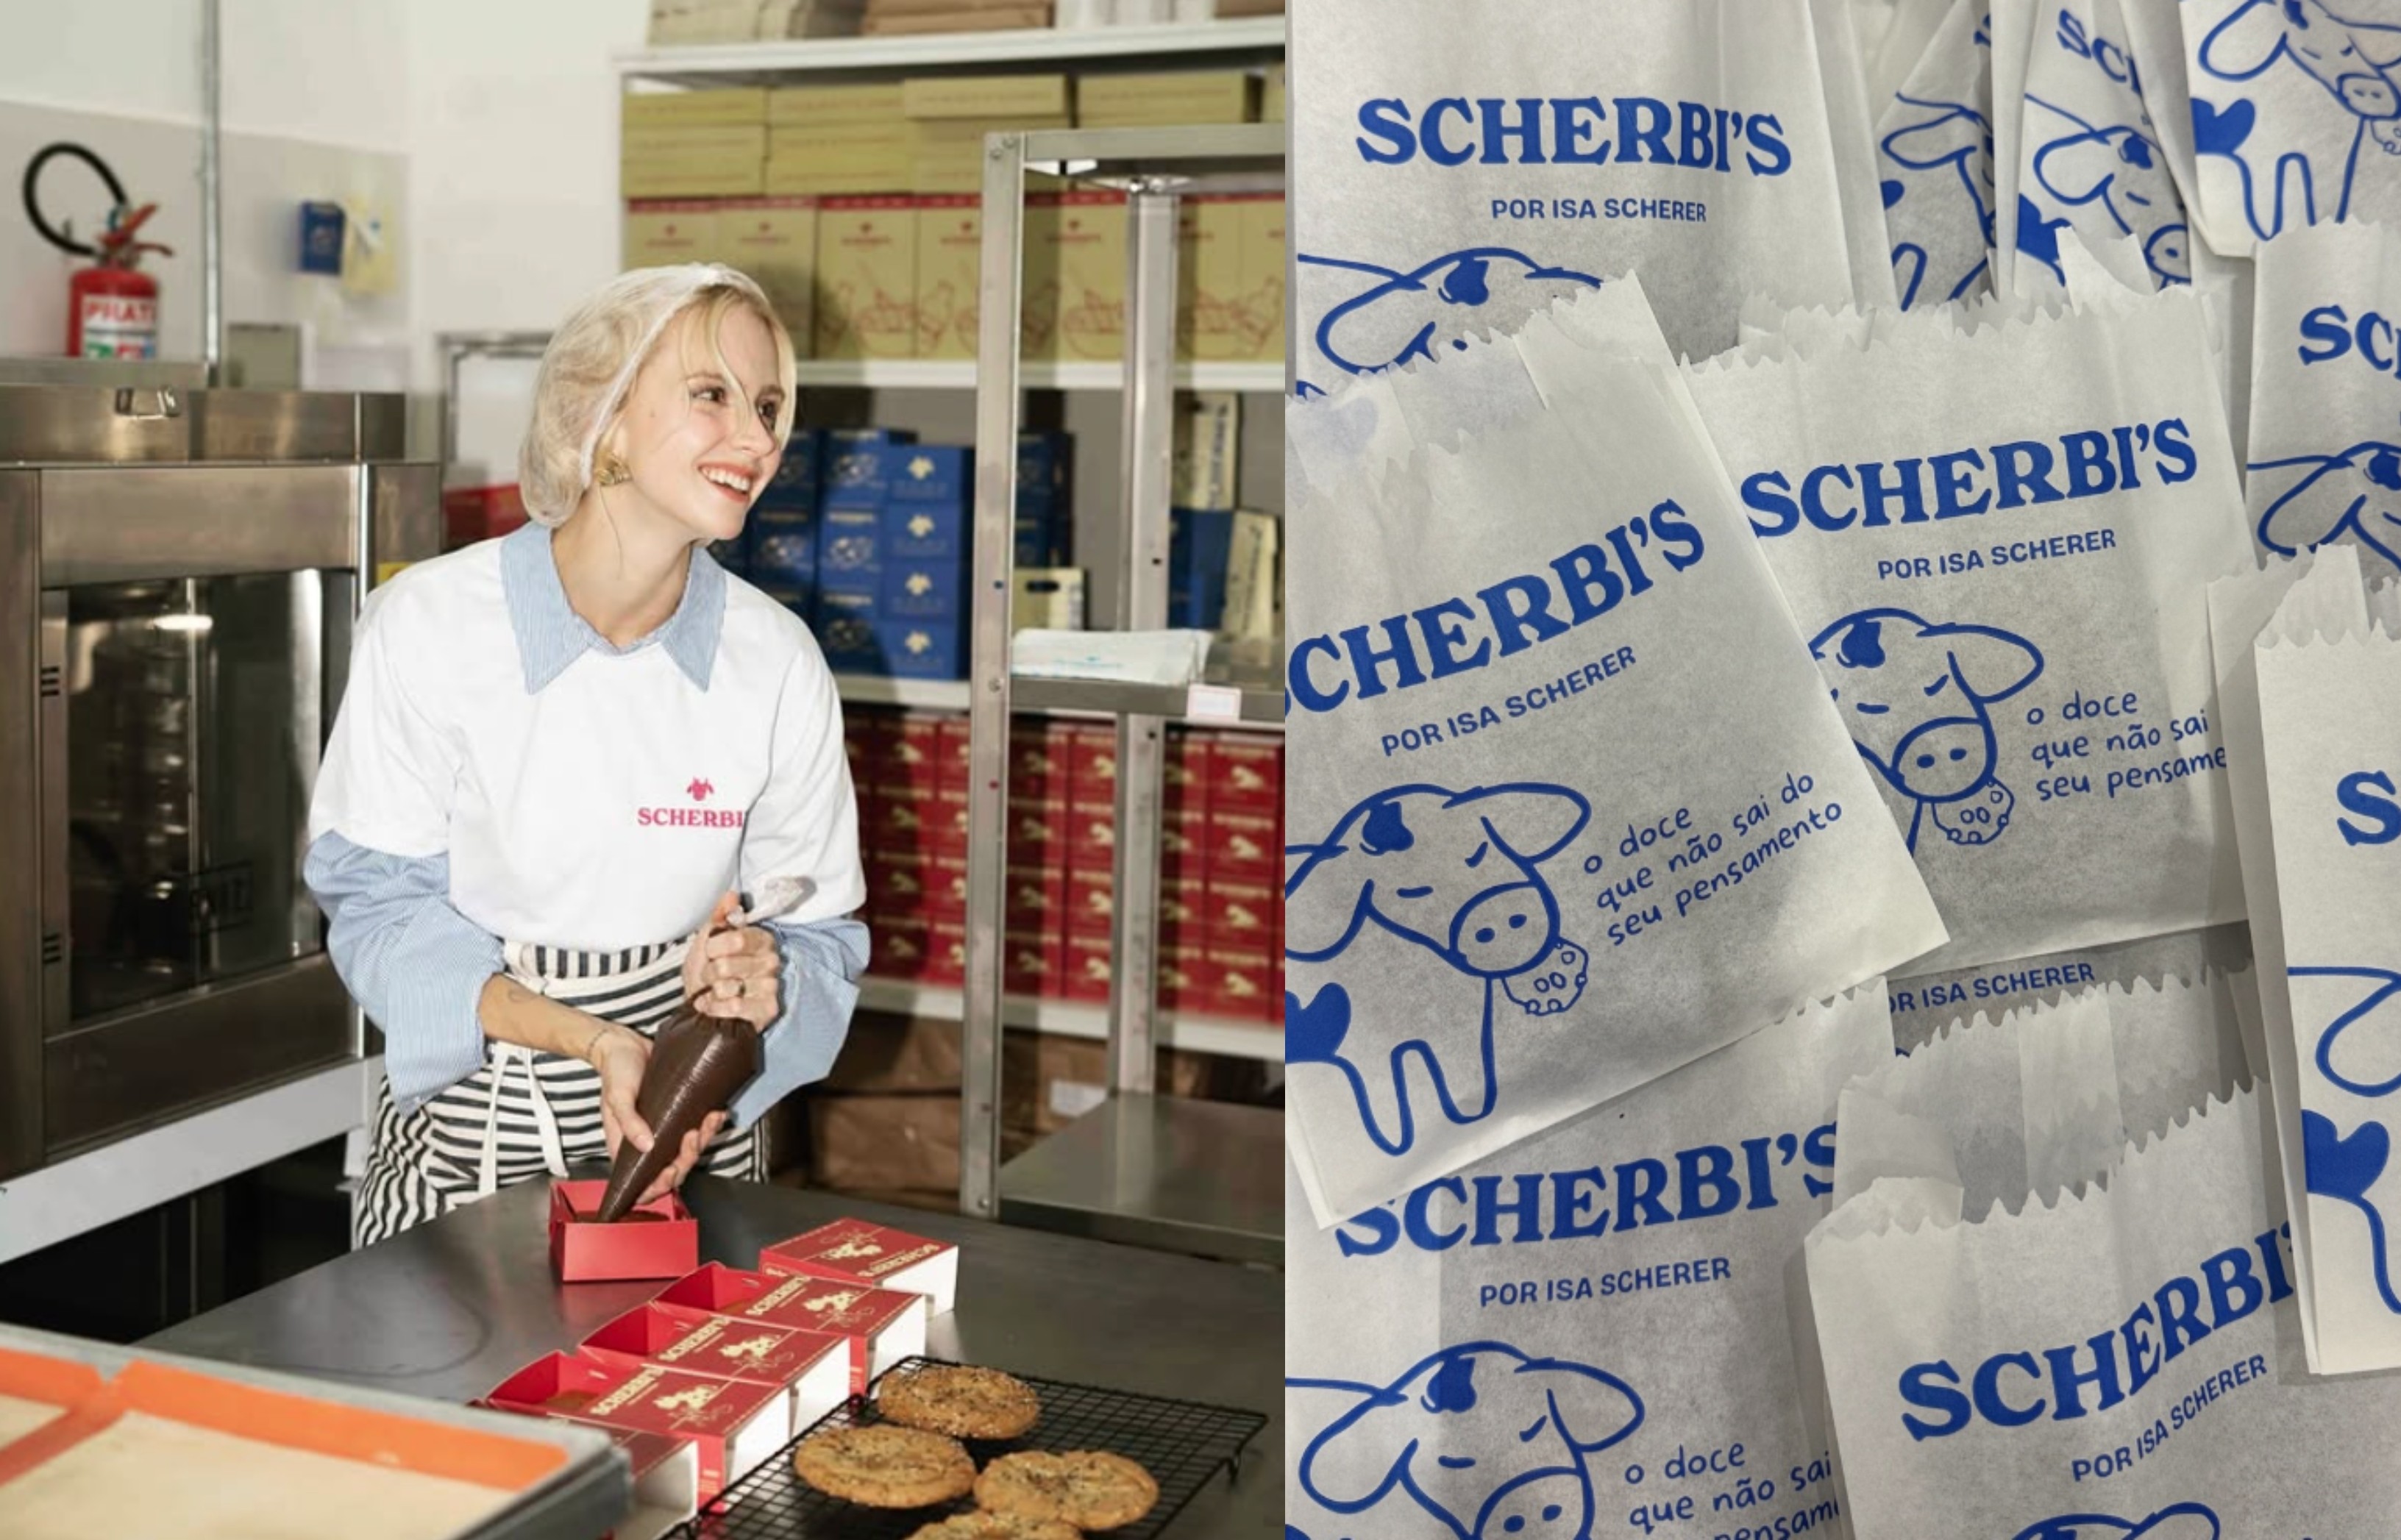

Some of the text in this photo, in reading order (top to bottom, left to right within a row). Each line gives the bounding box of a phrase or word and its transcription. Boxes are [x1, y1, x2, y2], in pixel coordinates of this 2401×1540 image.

[1356, 96, 1791, 176] SCHERBI'S
[1492, 199, 1706, 221] POR ISA SCHERER
[2298, 305, 2401, 380] SC
[1742, 418, 2197, 537] SCHERBI'S
[1878, 529, 2116, 580] POR ISA SCHERER
[1285, 499, 1704, 717] CHERBI'S
[1381, 646, 1635, 757] POR ISA SCHERER
[2027, 692, 2137, 724] o doce
[2031, 708, 2208, 769] que não sai
[638, 808, 743, 827] SCHERBI
[2036, 775, 2091, 802] seu
[1584, 808, 1692, 874] o doce
[1597, 772, 1813, 913] que não sai do
[1608, 803, 1841, 946] seu pensamento
[1921, 982, 1968, 1008] ISA
[1973, 962, 2094, 998] SCHERER
[1481, 1258, 1730, 1308] POR ISA SCHERER
[2072, 1355, 2267, 1482] POR ISA SCHERER
[1625, 1443, 1745, 1484] o doce
[1629, 1450, 1832, 1535] que não sai
